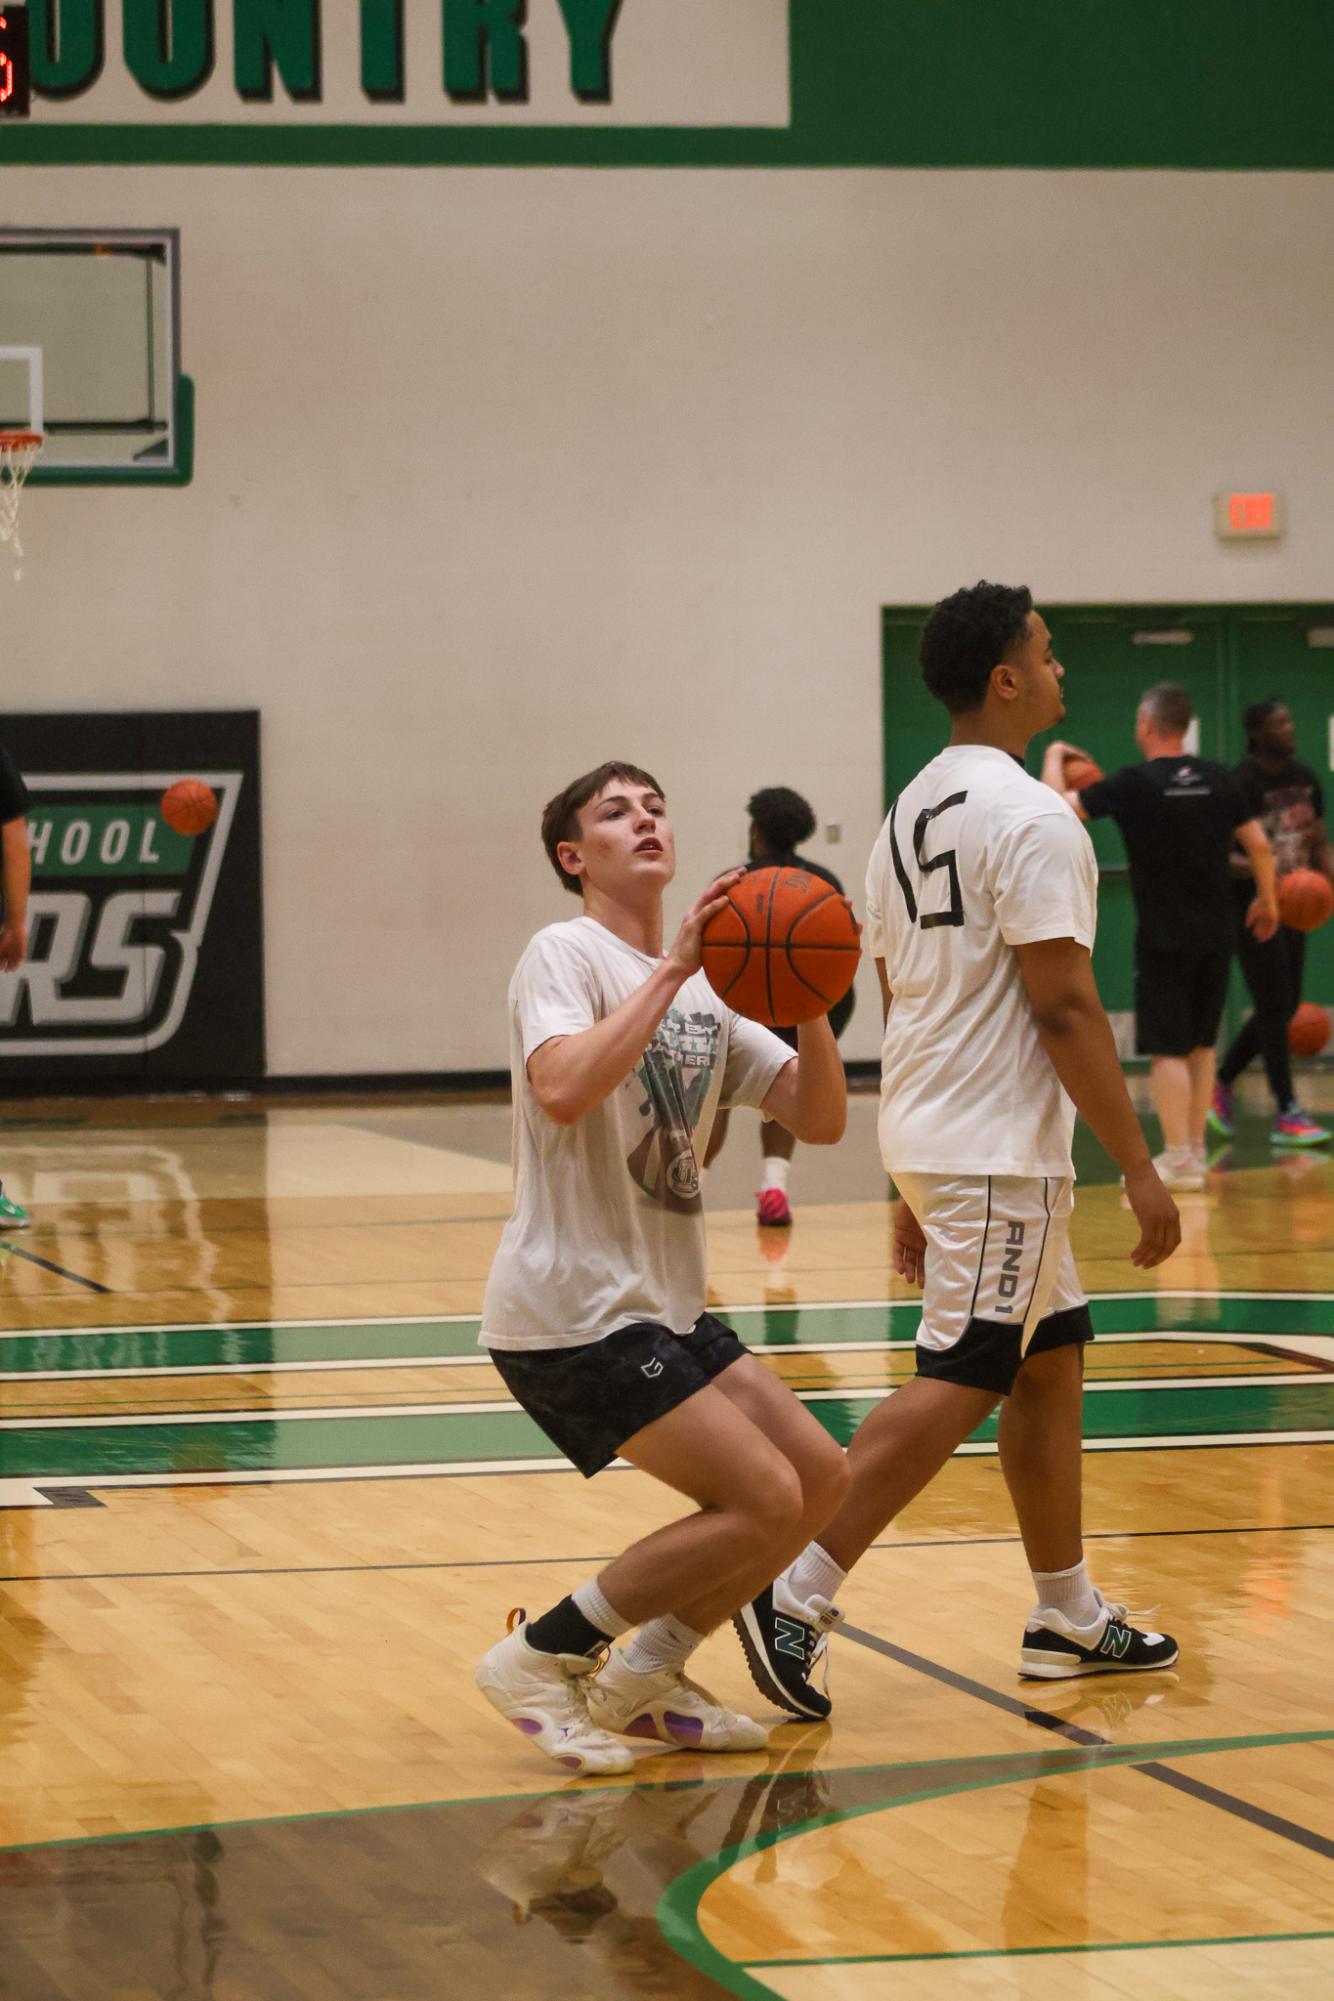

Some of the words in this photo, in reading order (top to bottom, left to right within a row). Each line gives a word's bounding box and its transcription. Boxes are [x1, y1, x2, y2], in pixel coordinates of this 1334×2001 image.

[889, 788, 968, 930] 15
[775, 1616, 805, 1660] N
[1100, 1625, 1132, 1658] N
